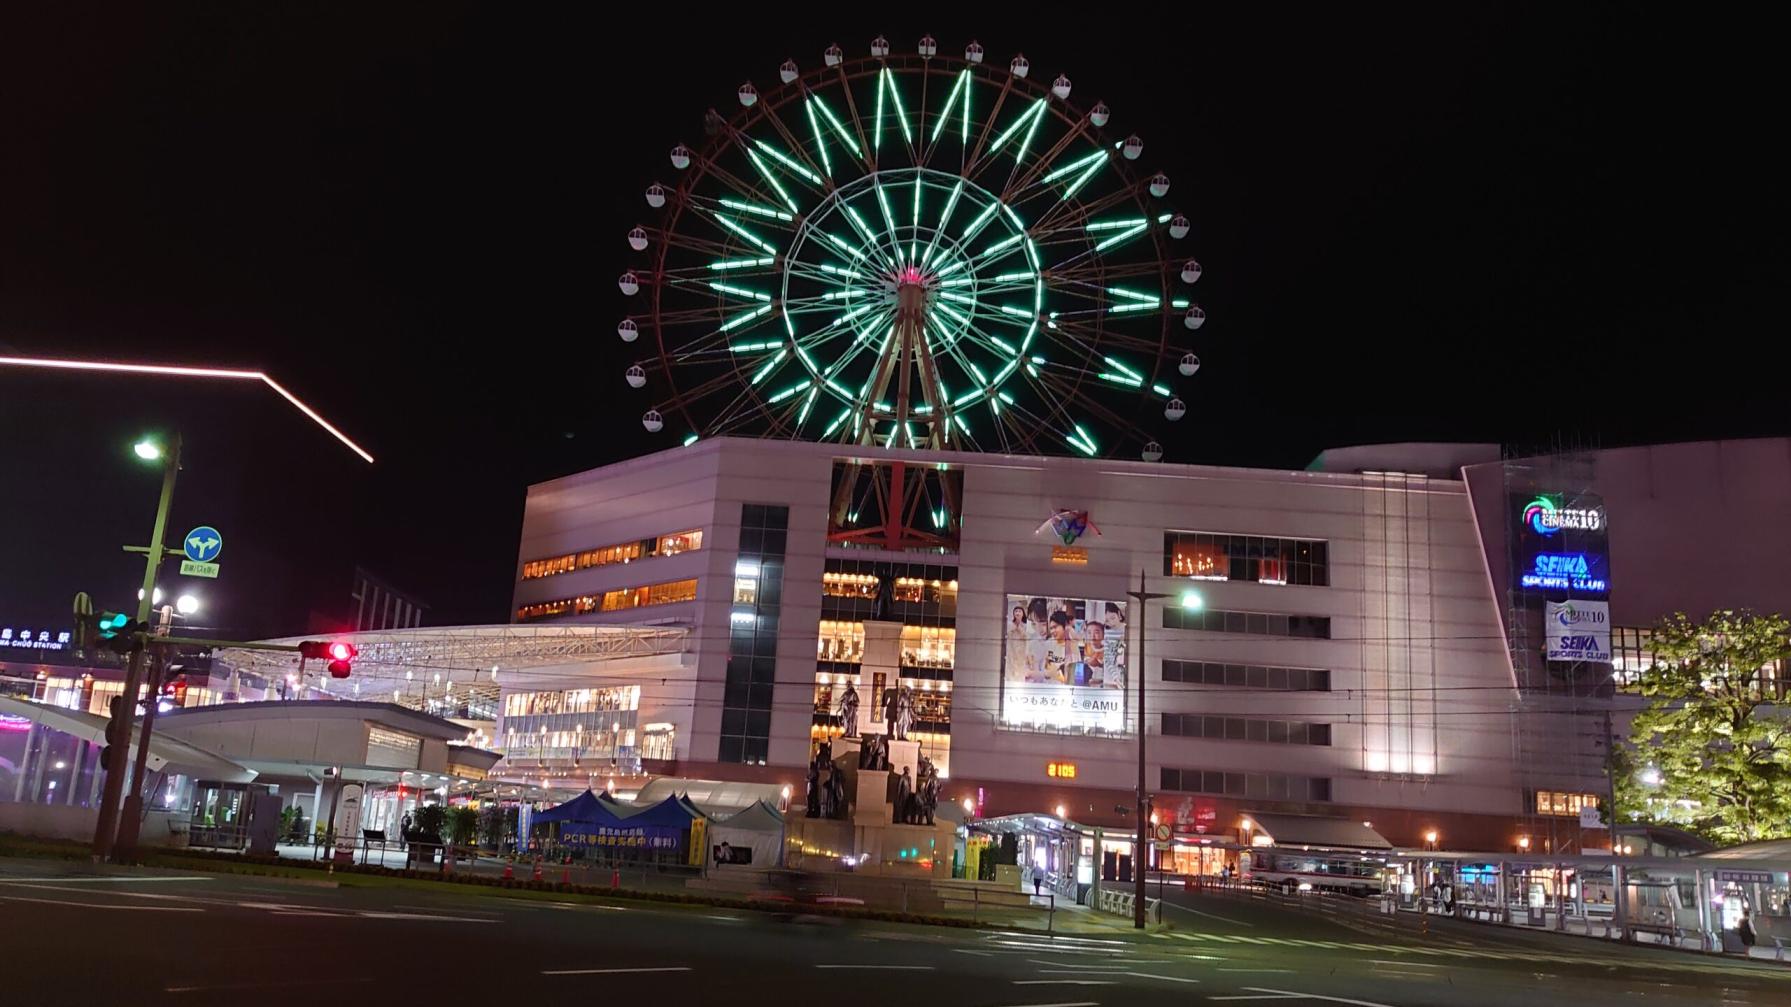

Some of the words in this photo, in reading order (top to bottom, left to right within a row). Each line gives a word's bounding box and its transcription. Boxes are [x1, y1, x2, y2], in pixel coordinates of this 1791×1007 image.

[1541, 516, 1579, 528] CINEMA
[1579, 509, 1600, 530] 10
[1592, 611, 1604, 623] 10
[33, 641, 62, 649] STATION
[1560, 635, 1599, 651] SEIKA
[1549, 650, 1583, 658] SPORTS
[1586, 651, 1609, 660] CLUB
[1083, 700, 1118, 712] @AMU
